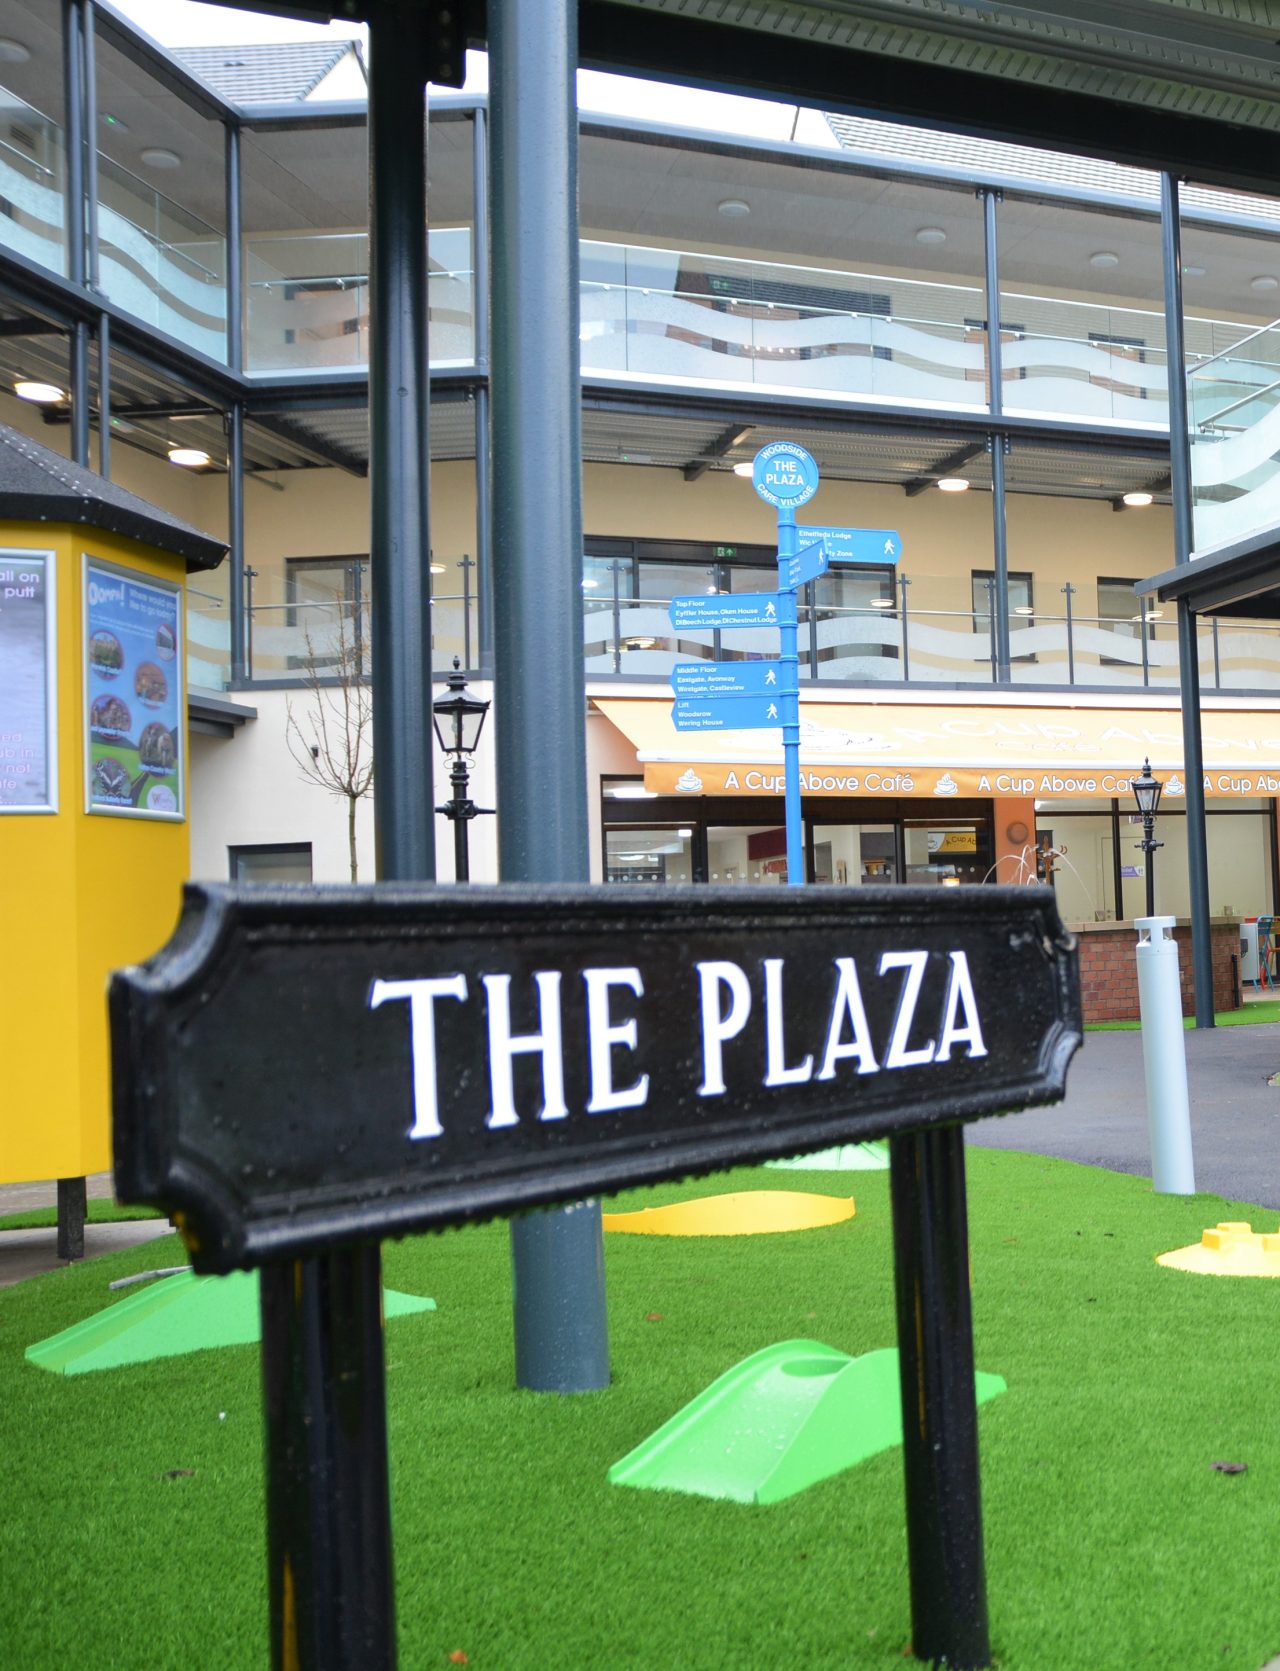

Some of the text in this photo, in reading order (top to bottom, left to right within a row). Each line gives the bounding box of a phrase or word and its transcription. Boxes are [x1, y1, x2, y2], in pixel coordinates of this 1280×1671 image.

[760, 444, 808, 461] WOODSIDE
[773, 460, 797, 472] THE
[766, 473, 804, 486] PLAZA
[757, 483, 814, 506] CARE VILLAGE
[831, 531, 852, 541] Lodge
[836, 550, 853, 558] Zone
[19, 573, 40, 583] on
[5, 586, 35, 600] putt
[676, 600, 688, 608] Top
[737, 607, 759, 615] House
[757, 616, 777, 624] Lodge
[700, 666, 717, 674] Floor
[724, 771, 914, 794] A Cup Above Café
[978, 775, 1135, 795] A Cup Above Caf
[1202, 775, 1213, 791] A
[1217, 775, 1251, 794] Cup
[369, 950, 989, 1140] THE PLAZA
